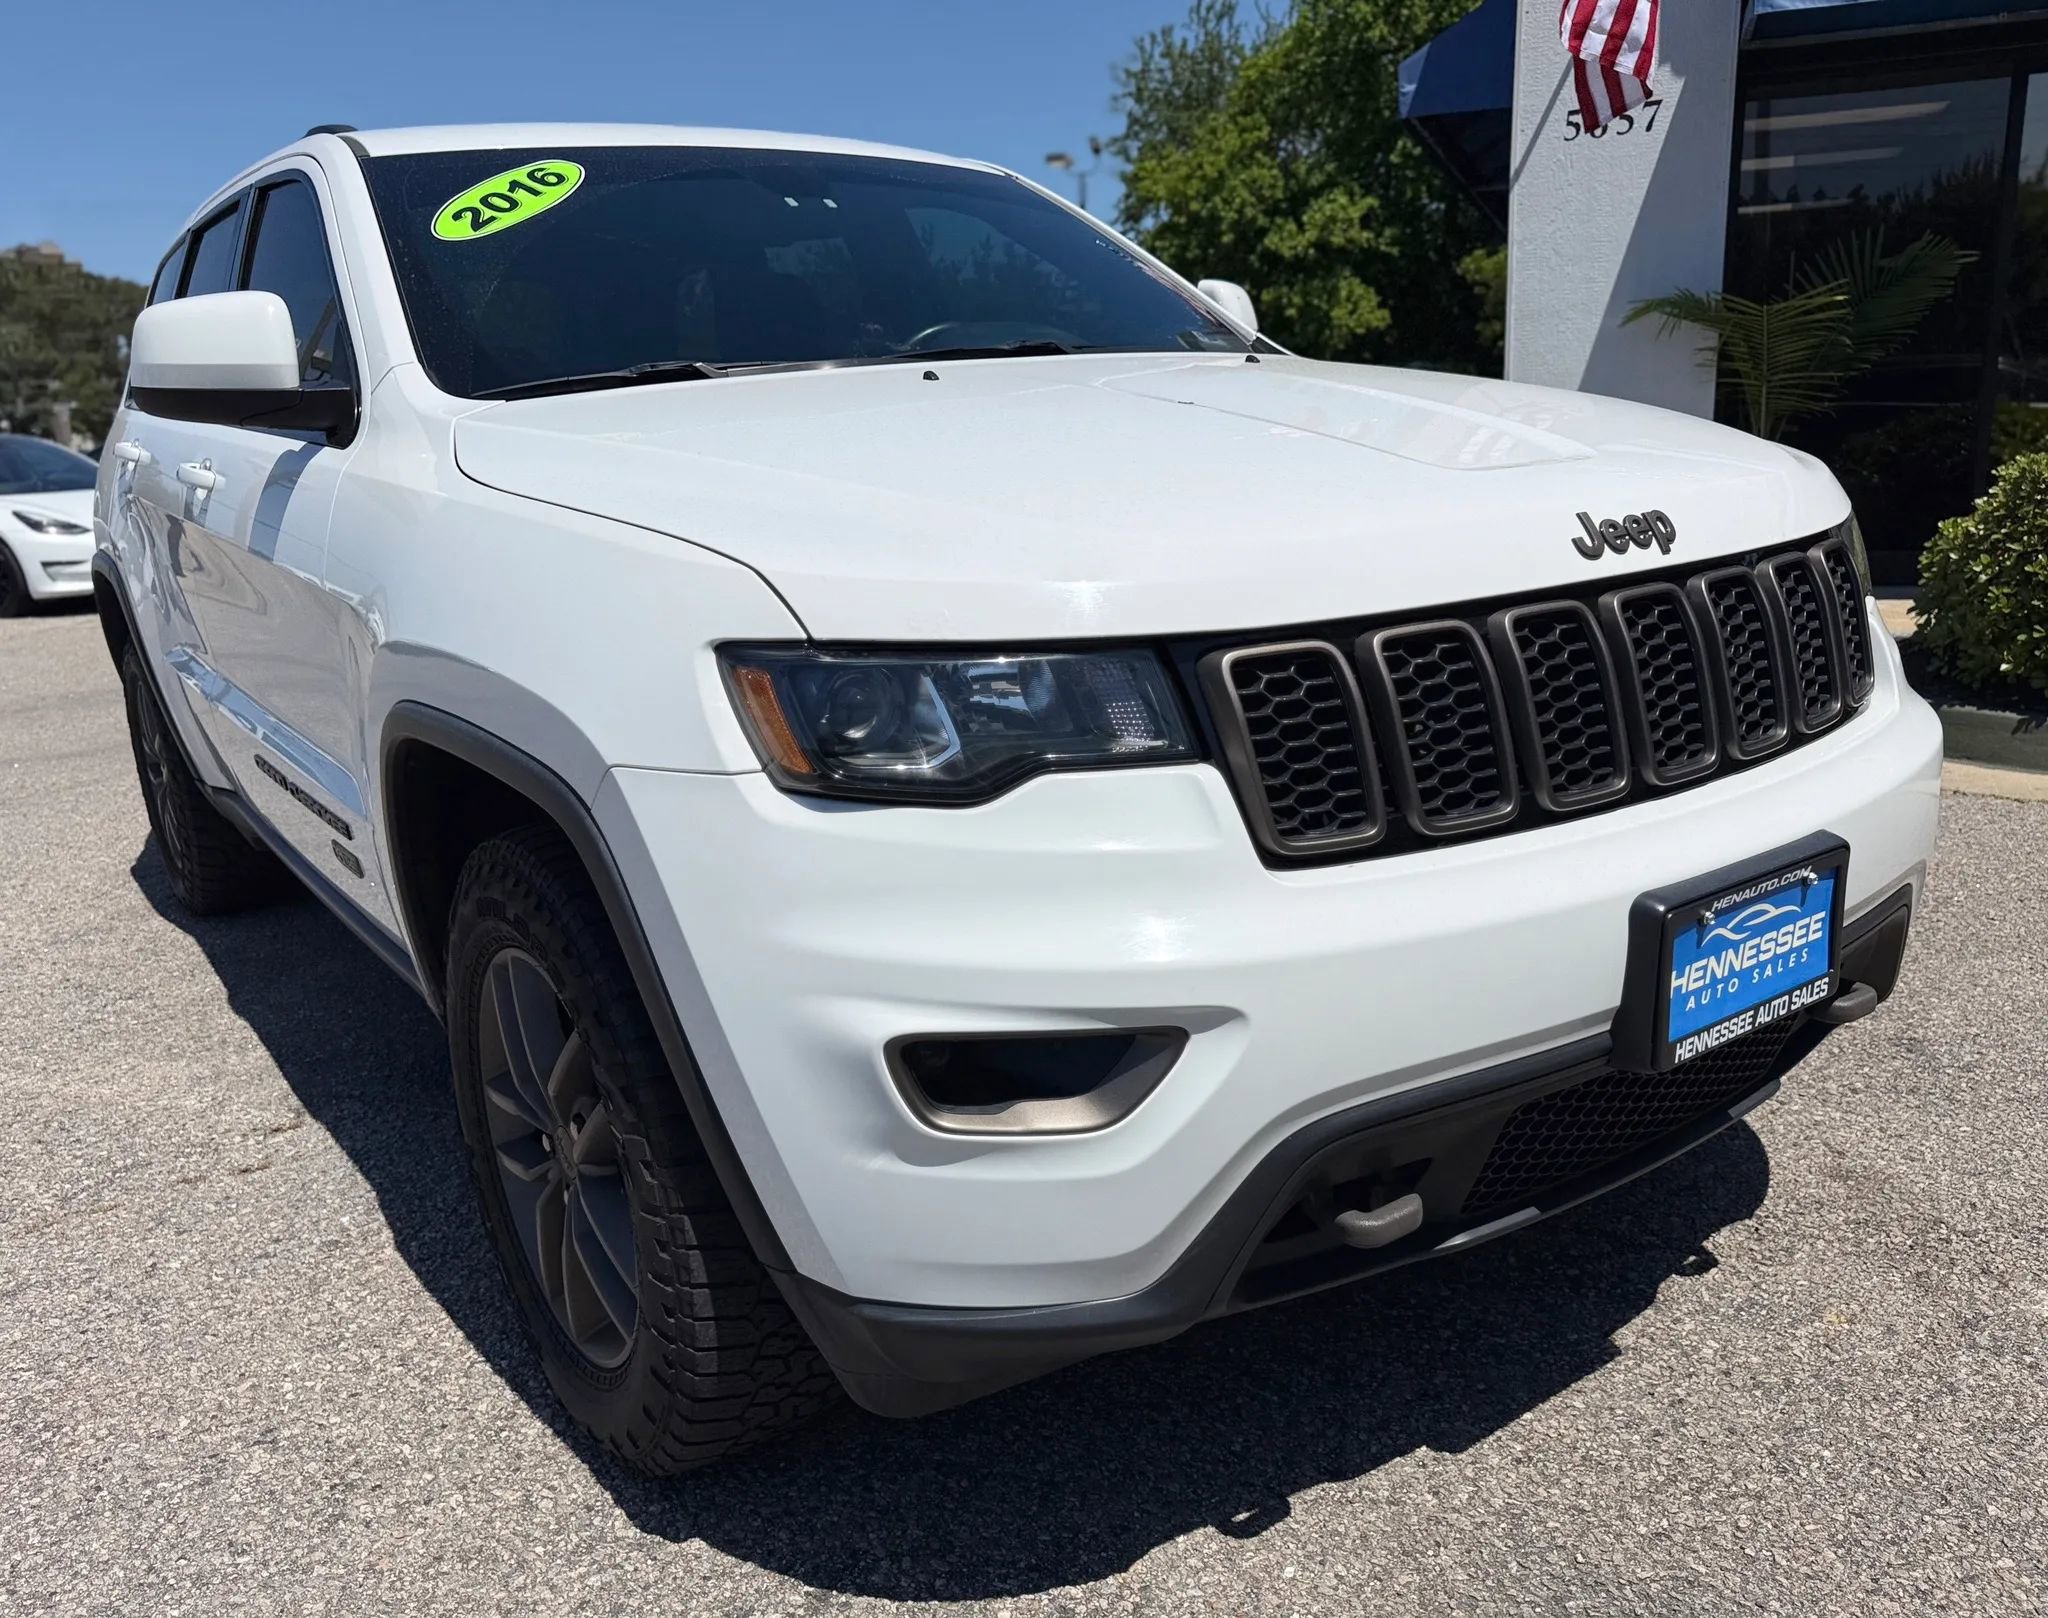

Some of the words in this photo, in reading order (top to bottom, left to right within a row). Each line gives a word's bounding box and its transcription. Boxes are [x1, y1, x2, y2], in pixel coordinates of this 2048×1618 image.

[451, 167, 569, 233] 2016
[1571, 509, 1677, 561] Jeep
[1711, 865, 1813, 913] HENAUTO.COM
[1670, 910, 1826, 999] HENNESSEE
[1685, 979, 1739, 1012] AUTO
[1751, 948, 1809, 984] SALES
[1674, 1010, 1753, 1064] HENNESSEE
[1754, 996, 1789, 1028] AUTO
[1791, 977, 1830, 1012] SALES
